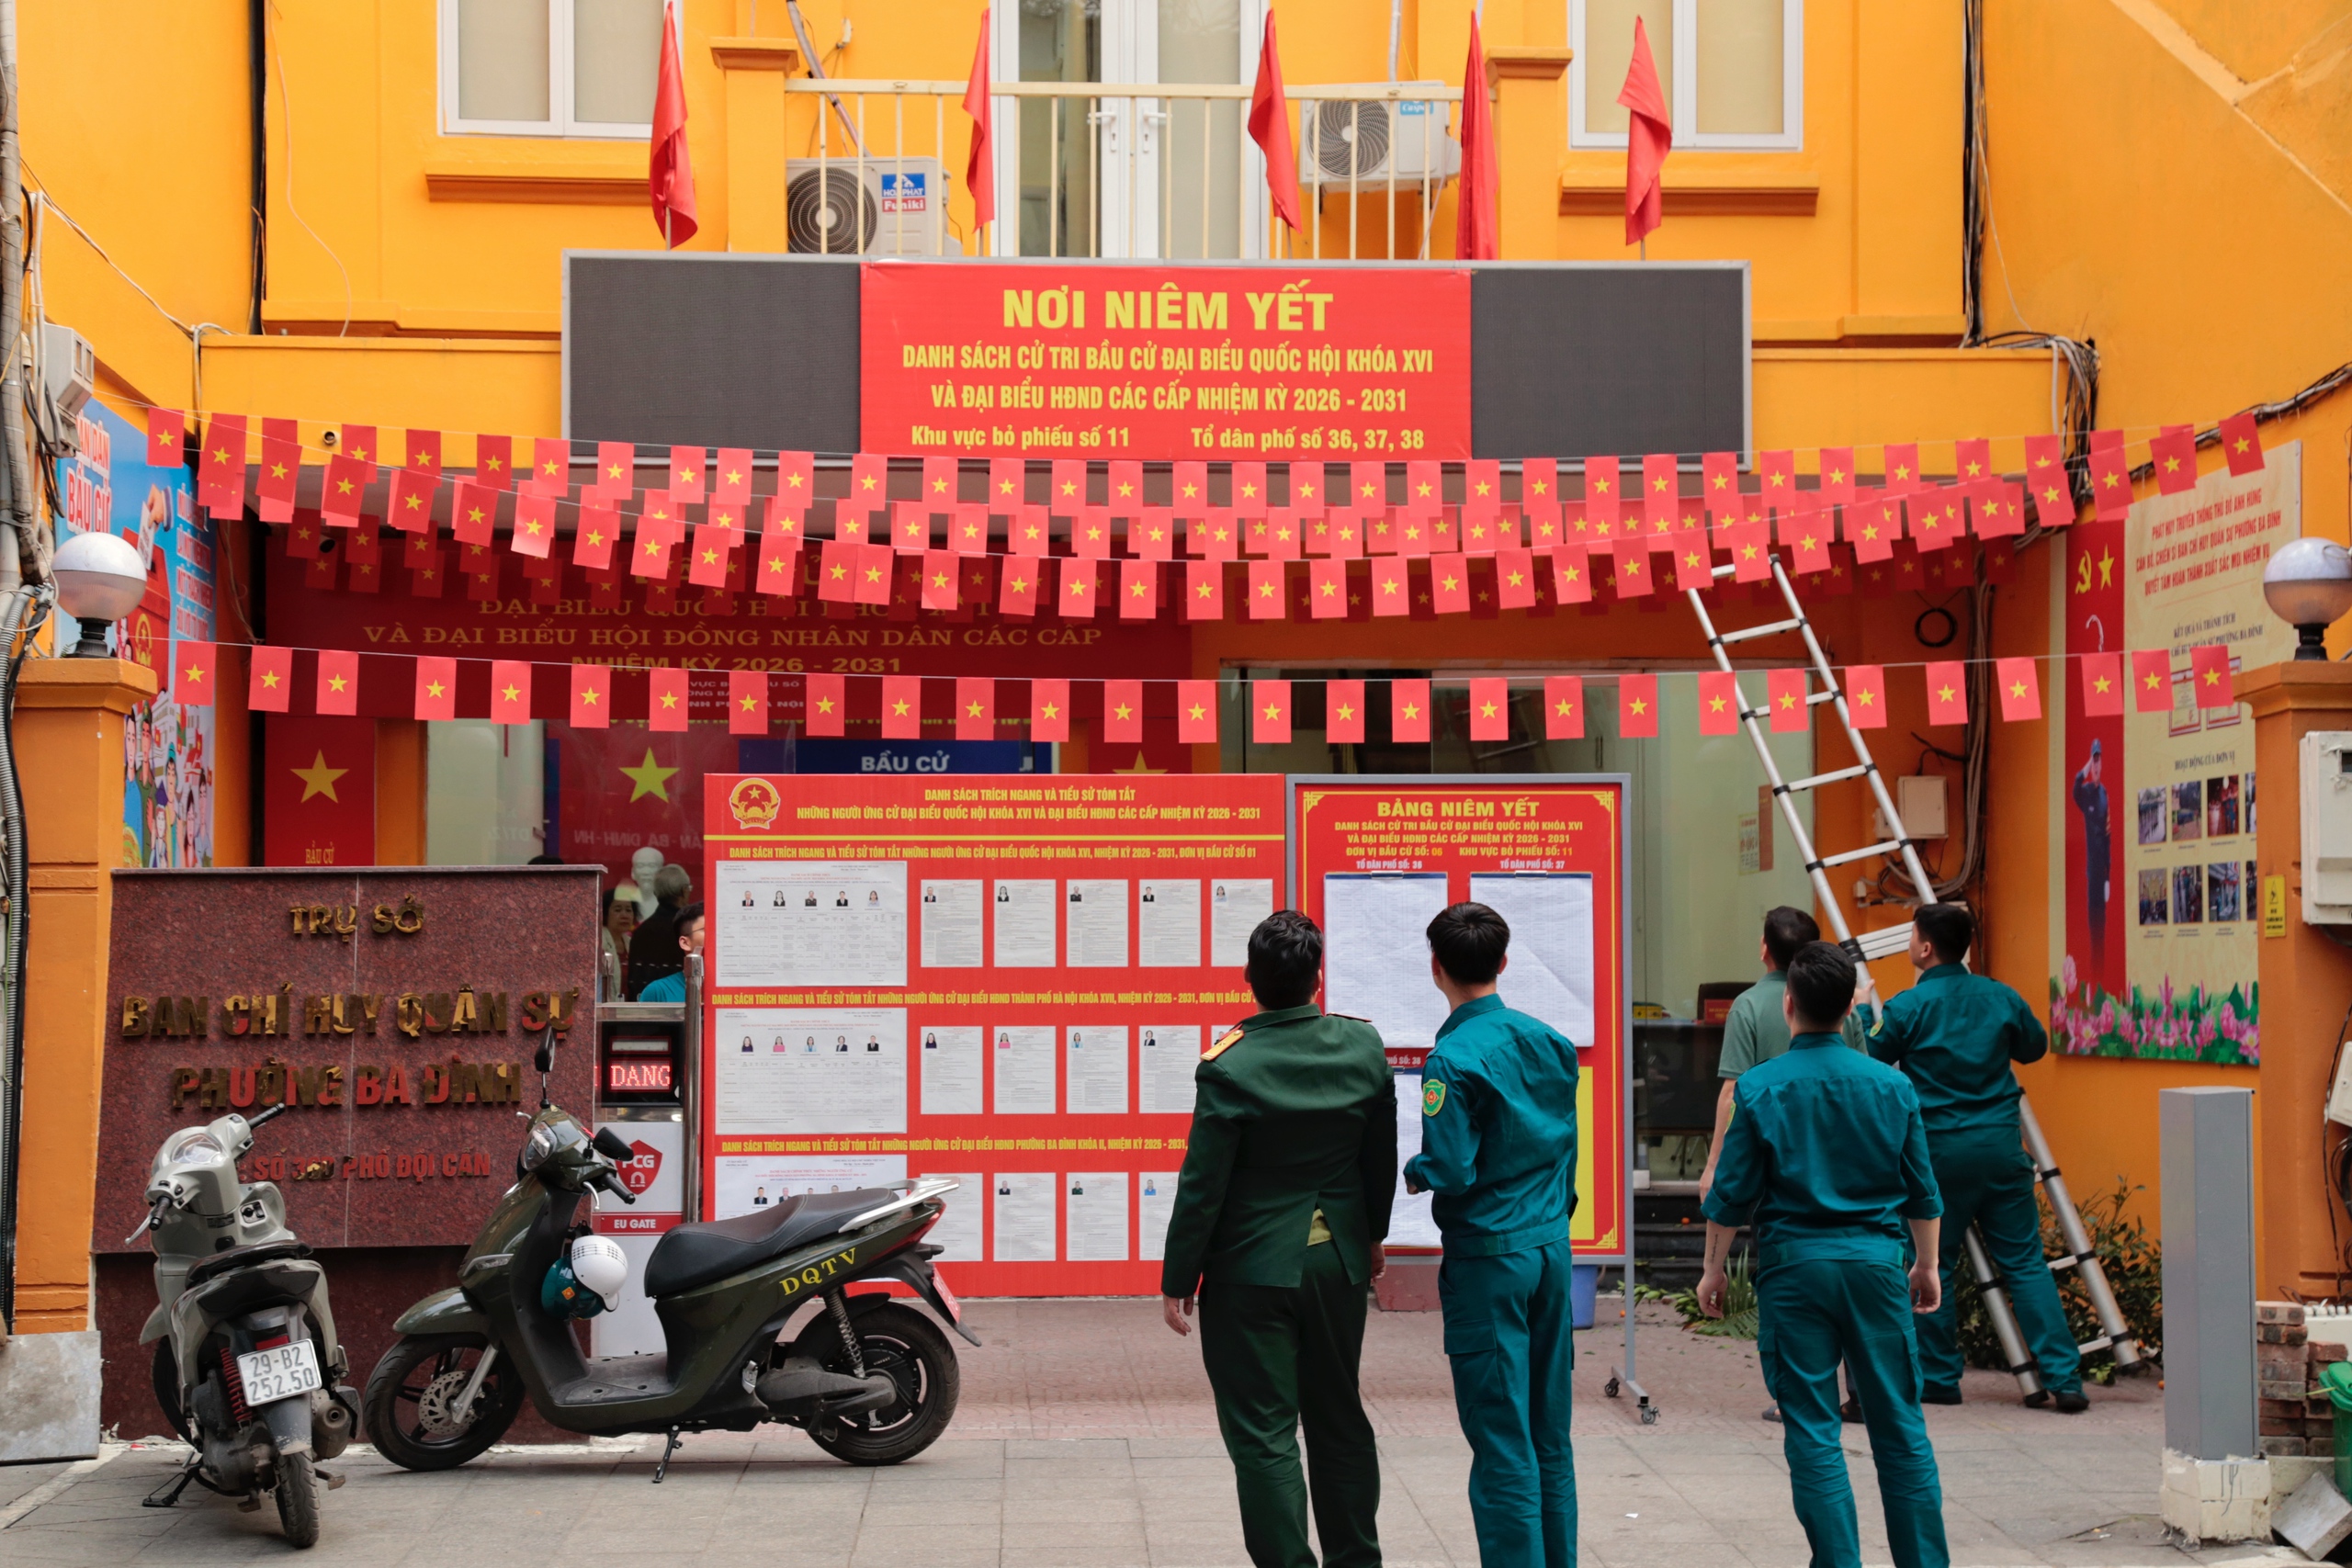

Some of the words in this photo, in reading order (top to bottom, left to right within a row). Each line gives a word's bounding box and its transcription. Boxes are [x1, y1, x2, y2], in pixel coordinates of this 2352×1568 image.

[1004, 285, 1084, 329] NƠI
[1106, 282, 1227, 330] NIÊM
[1246, 279, 1333, 331] YẾT
[903, 345, 954, 367] DANH
[961, 341, 1011, 368] SÁCH
[1017, 340, 1045, 369] CỬ
[1049, 347, 1080, 369] TRI
[1086, 339, 1123, 369] BẦU
[1130, 341, 1157, 370] CỬ
[1161, 348, 1193, 375] ĐẠI
[1200, 340, 1243, 371] BIỂU
[1250, 341, 1301, 373] QUỐC
[1308, 344, 1340, 377] HỘI
[1347, 344, 1396, 372] KHÓA
[1403, 350, 1432, 372] XVI
[932, 379, 956, 407] VÀ
[961, 386, 993, 412] ĐẠI
[1001, 376, 1044, 409] BIỂU
[1051, 387, 1102, 409] HĐND
[1109, 381, 1147, 410] CÁC
[1153, 379, 1191, 410] CẤP
[1197, 382, 1258, 415] NHIỆM
[1265, 383, 1288, 410] KỲ
[1294, 389, 1340, 411] 2026
[1362, 389, 1406, 412] 2031
[912, 425, 946, 446] Khu
[953, 428, 986, 450] vực
[992, 424, 1015, 446] bỏ
[1022, 424, 1073, 450] phiếu
[1080, 424, 1102, 446] số
[1108, 427, 1128, 446] 11
[1191, 424, 1214, 447] Tổ
[1220, 428, 1254, 447] dân
[1261, 426, 1296, 452] phố
[1301, 427, 1323, 448] số
[1329, 429, 1358, 451] 36,
[1364, 429, 1394, 452] 37,
[1401, 430, 1424, 449] 38
[364, 623, 411, 643] VÀ
[423, 627, 484, 648] ĐẠI
[496, 617, 577, 645] BIỂU
[589, 624, 650, 649] HỘI
[663, 621, 761, 646] ĐỒNG
[771, 625, 869, 646] NHÂN
[882, 625, 954, 646] DÂN
[964, 626, 1028, 646] CÁC
[1037, 624, 1103, 646] CẤP
[687, 653, 721, 671] KỲ
[732, 658, 804, 672] 2026
[831, 658, 900, 672] 2031
[862, 750, 909, 773] BẦU
[915, 750, 950, 773] CỬ
[925, 789, 951, 800] DANH
[953, 787, 978, 800] SÁCH
[980, 787, 1008, 800] TRÍCH
[1010, 789, 1042, 801] NGANG
[1045, 787, 1057, 800] VÀ
[1058, 785, 1079, 801] TIỂU
[1081, 786, 1095, 801] SỬ
[1096, 788, 1116, 801] TÓM
[1119, 785, 1136, 800] TẮT
[1378, 798, 1433, 817] BẢNG
[1442, 799, 1494, 817] NIÊM
[1501, 797, 1539, 817] YẾT
[797, 806, 830, 818] NHỮNG
[832, 806, 861, 818] NGƯỜI
[864, 806, 883, 818] ỨNG
[886, 805, 899, 818] CỬ
[900, 807, 917, 821] ĐẠI
[920, 804, 941, 818] BIỂU
[944, 805, 968, 820] QUỐC
[970, 806, 987, 821] HỘI
[989, 806, 1014, 818] KHÓA
[1016, 808, 1032, 818] XVI
[1034, 806, 1046, 818] VÀ
[1048, 807, 1064, 821] ĐẠI
[1067, 804, 1088, 819] BIỂU
[1090, 807, 1115, 818] HĐND
[1118, 806, 1136, 818] CÁC
[1139, 805, 1158, 818] CẤP
[1160, 806, 1191, 821] NHIỆM
[1193, 806, 1205, 818] KỲ
[1207, 807, 1230, 818] 2026
[1238, 807, 1260, 818] 2031
[1335, 822, 1359, 830] DANH
[1362, 820, 1385, 830] SÁCH
[1388, 820, 1400, 830] CỬ
[1403, 822, 1417, 830] TRI
[1419, 819, 1438, 830] BẦU
[1441, 820, 1453, 830] CỬ
[1455, 822, 1470, 831] ĐẠI
[1473, 818, 1494, 830] BIỂU
[1496, 819, 1521, 830] QUỐC
[1523, 820, 1539, 831] HỘI
[1542, 820, 1566, 830] KHÓA
[1568, 822, 1582, 830] XVI
[1348, 833, 1359, 843] VÀ
[1362, 835, 1376, 844] ĐẠI
[1379, 831, 1400, 843] BIỂU
[1403, 835, 1428, 843] HĐND
[1430, 833, 1448, 843] CÁC
[1451, 832, 1468, 843] CẤP
[1471, 833, 1500, 844] NHIỆM
[1503, 833, 1514, 842] KỲ
[1517, 834, 1539, 843] 2026
[1548, 834, 1569, 843] 2031
[289, 905, 356, 942] TRỤ
[371, 894, 425, 933] SỞ
[122, 995, 208, 1036] BAN
[223, 980, 294, 1035] CHỈ
[306, 993, 382, 1034] HUY
[397, 983, 508, 1038] QUÂN
[521, 987, 579, 1041] SỰ
[171, 1055, 344, 1109] PHƯỜNG
[356, 1066, 412, 1105] BA
[423, 1055, 521, 1104] ĐÌNH
[611, 1066, 671, 1087] DANG
[614, 1220, 627, 1228] EU
[629, 1219, 657, 1229] GATE
[779, 1247, 856, 1295] DQTV
[250, 1347, 303, 1377] 29-B2
[249, 1368, 314, 1401] 252.50
